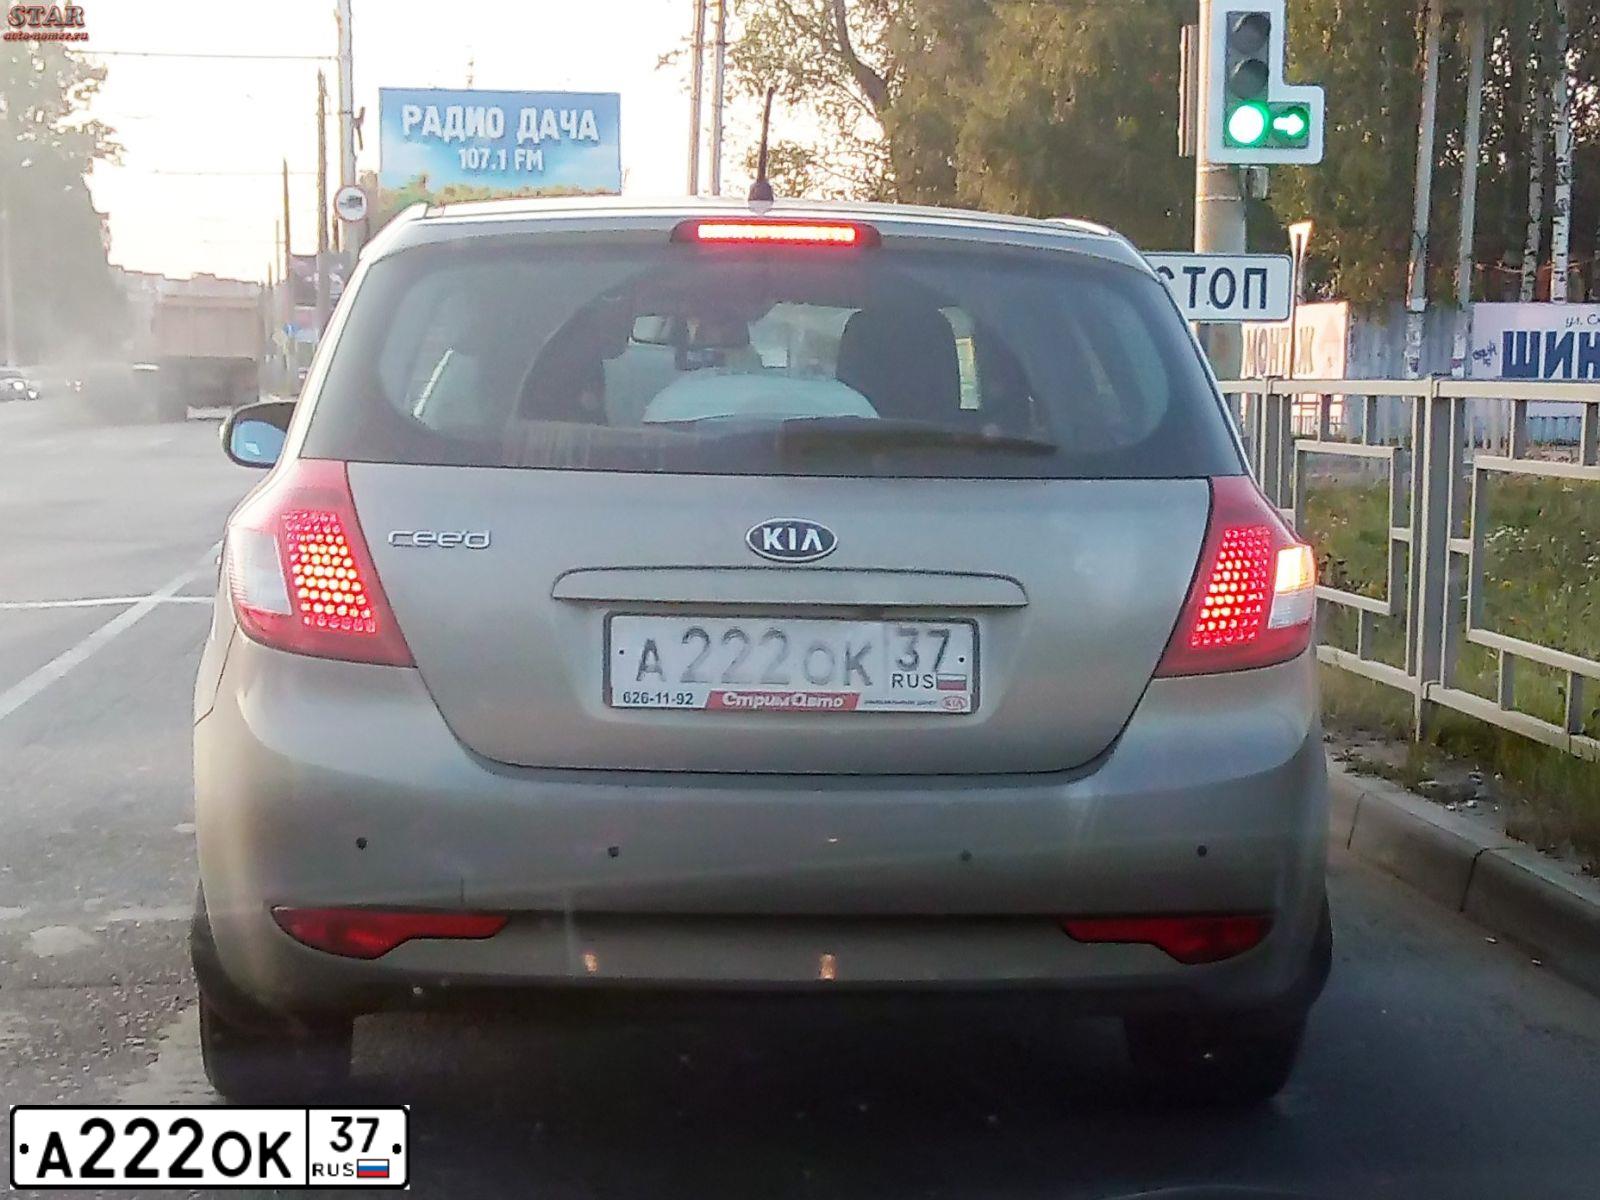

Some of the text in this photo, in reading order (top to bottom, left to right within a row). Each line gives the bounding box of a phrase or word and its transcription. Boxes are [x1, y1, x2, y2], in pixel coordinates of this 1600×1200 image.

[402, 104, 600, 144] РАДИО ДАЧА
[458, 148, 544, 171] 107.1 FM
[1157, 266, 1267, 309] ТОП
[1244, 326, 1315, 376] МОНТЖ
[762, 527, 823, 551] KIA
[894, 627, 950, 672] 37
[891, 673, 934, 689] RUS
[623, 692, 694, 706] 626-11-92
